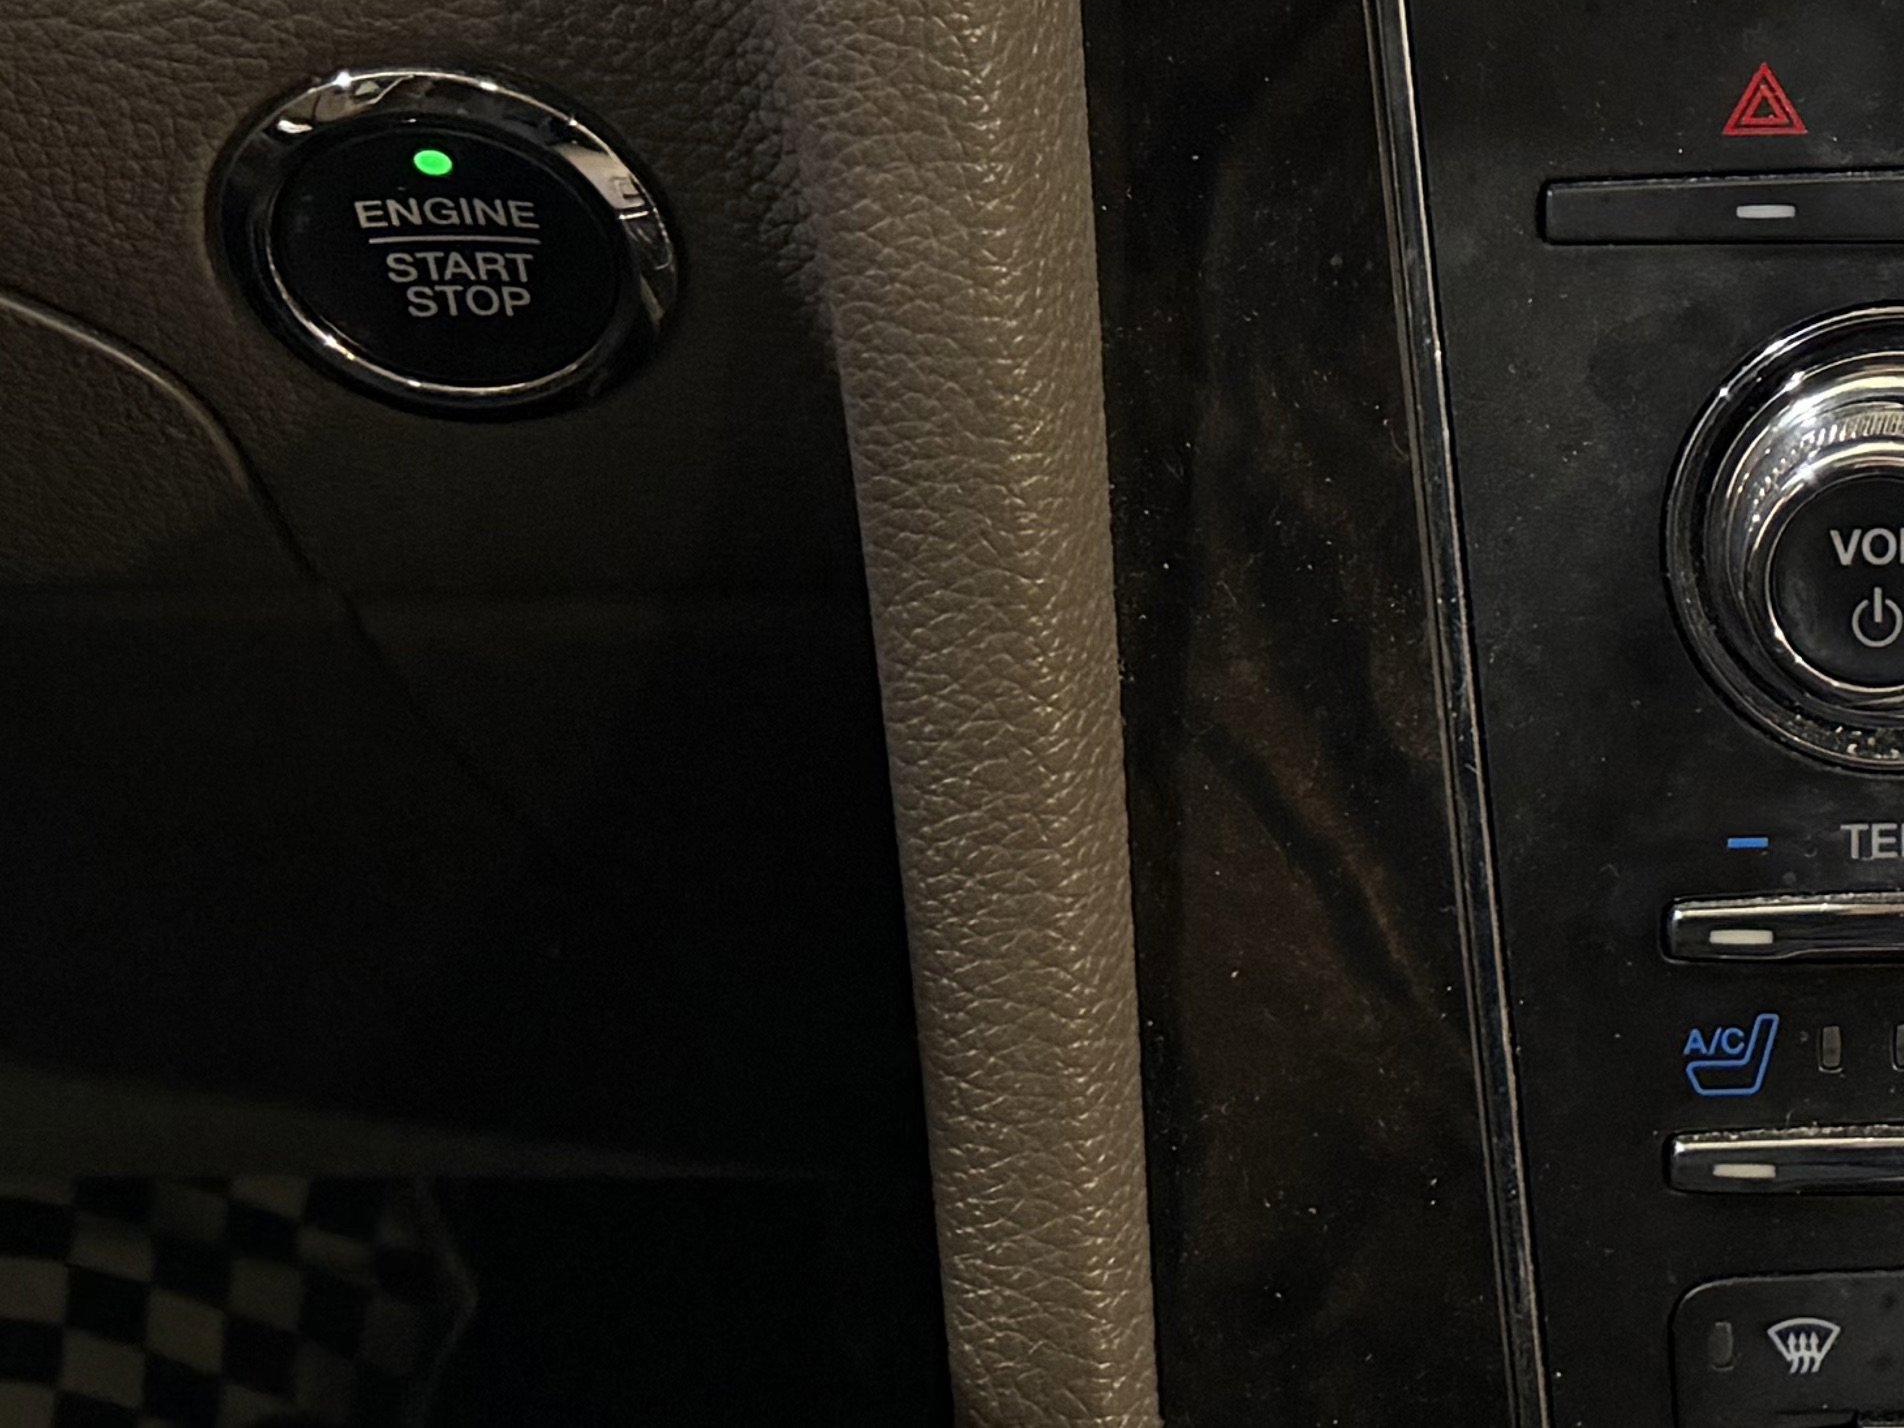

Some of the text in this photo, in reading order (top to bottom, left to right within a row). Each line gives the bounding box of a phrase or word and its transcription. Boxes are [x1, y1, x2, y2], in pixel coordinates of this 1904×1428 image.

[354, 197, 540, 229] ENGINE
[386, 252, 534, 283] START
[406, 286, 531, 317] STOP
[1683, 1026, 1747, 1056] A/C
